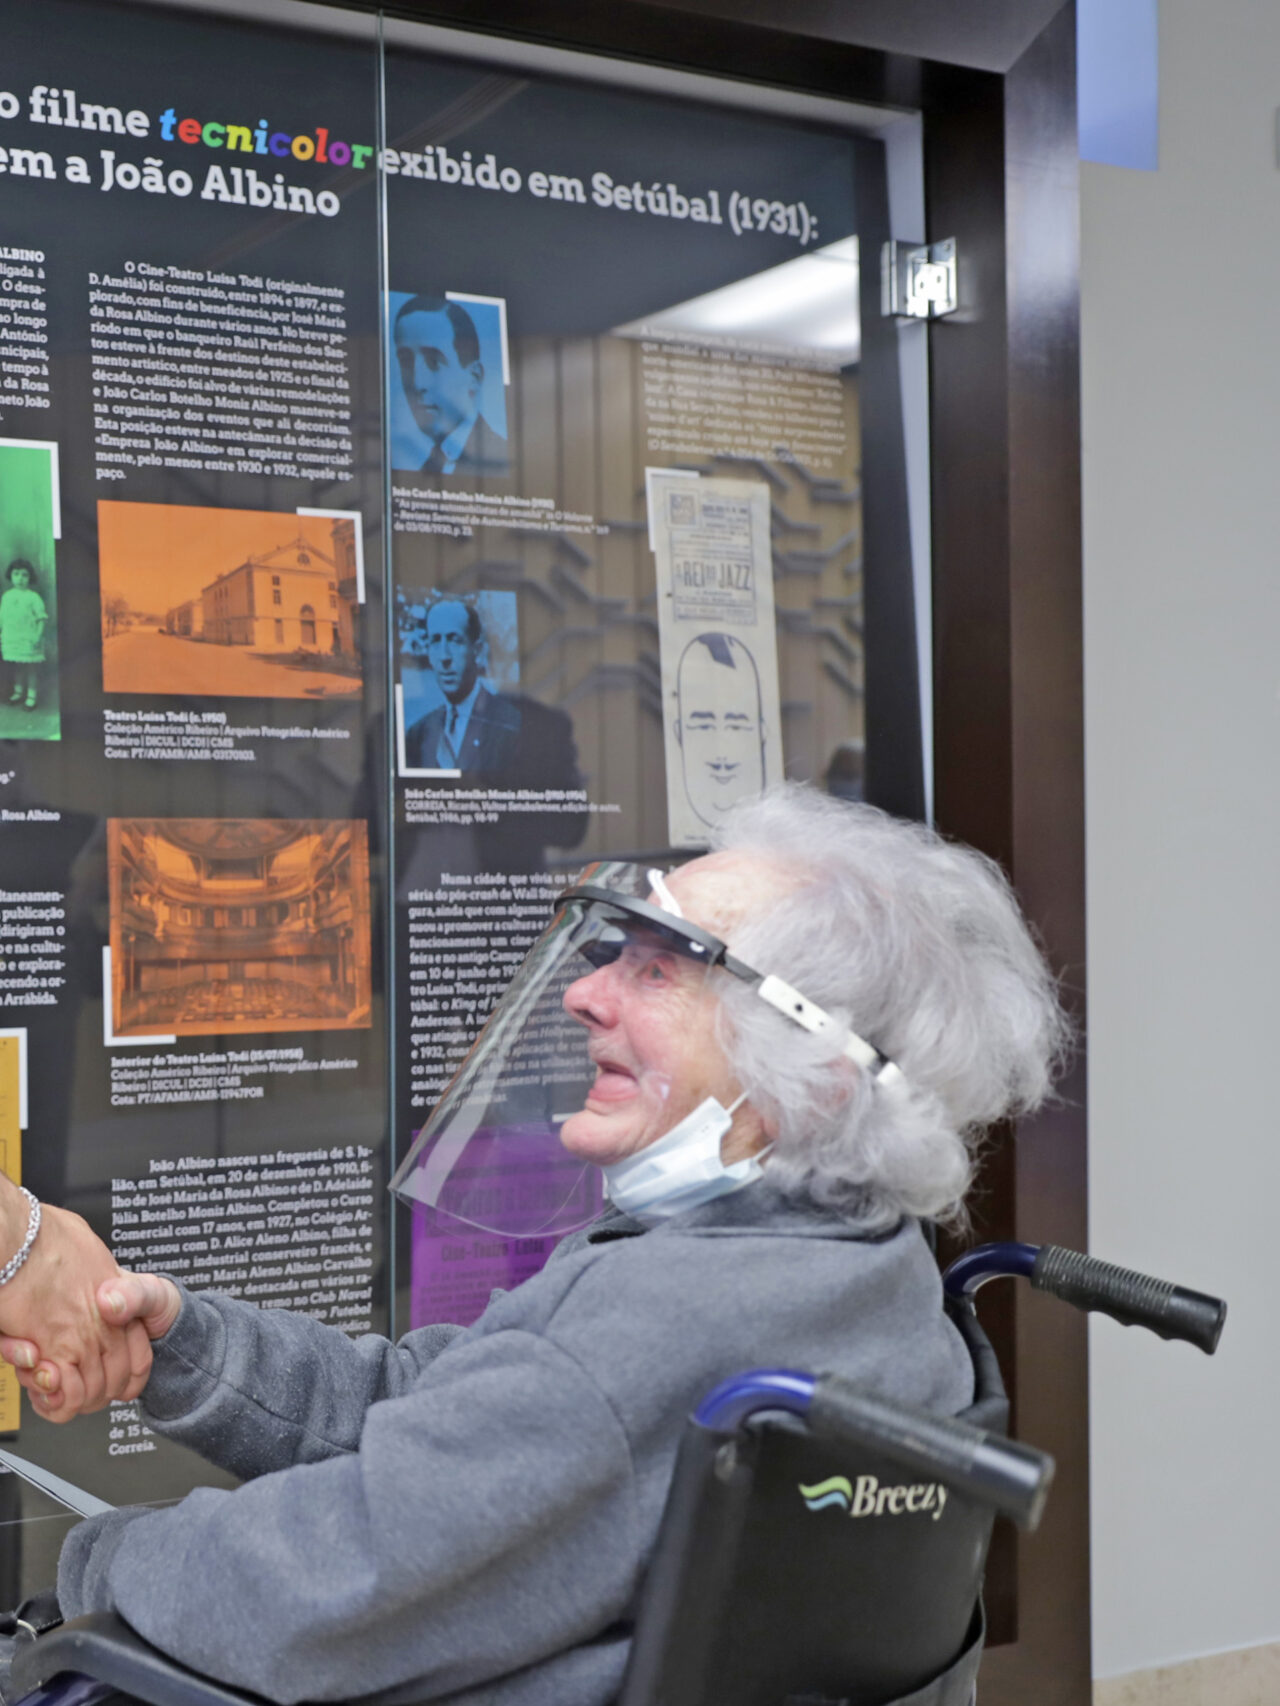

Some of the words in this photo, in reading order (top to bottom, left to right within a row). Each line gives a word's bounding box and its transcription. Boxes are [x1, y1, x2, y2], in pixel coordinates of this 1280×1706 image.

[29, 85, 150, 137] filme
[159, 107, 373, 169] tecnicolor
[378, 145, 521, 193] exibido
[528, 172, 586, 202] em
[592, 172, 723, 224] Setúbal
[728, 190, 819, 245] (1931):
[65, 155, 91, 184] a
[100, 149, 193, 197] João
[201, 164, 340, 217] Albino
[37, 266, 45, 279] à
[124, 260, 135, 272] O
[137, 261, 204, 281] Cine-Teatro
[206, 270, 236, 285] Luísa
[238, 274, 263, 288] Todi
[265, 277, 344, 298] (originalmente
[1, 278, 13, 291] O
[14, 279, 45, 294] desa-
[88, 272, 101, 285] D.
[102, 274, 147, 293] Amélia)
[148, 279, 164, 292] foi
[165, 284, 228, 301] construído,
[227, 290, 258, 302] entre
[259, 291, 284, 305] 1894
[285, 297, 292, 306] e
[294, 295, 321, 311] 1897,
[320, 301, 327, 310] e
[328, 302, 345, 312] ex-
[30, 297, 46, 311] de
[88, 289, 136, 306] plorado,
[135, 296, 161, 307] com
[162, 296, 184, 310] fins
[184, 299, 198, 311] de
[199, 300, 272, 321] beneficência,
[271, 311, 290, 323] por
[291, 310, 313, 324] José
[314, 313, 346, 328] Maria
[13, 311, 47, 330] longo
[719, 563, 751, 591] JAZZ
[440, 872, 472, 884] Numa
[473, 872, 507, 884] cidade
[508, 875, 528, 887] que
[2, 906, 65, 922] publicação
[56, 926, 65, 935] o
[409, 935, 487, 948] funcionamento
[489, 937, 507, 946] um
[109, 1426, 125, 1439] de
[127, 1425, 141, 1437] 15
[850, 1475, 947, 1521] Breezy
